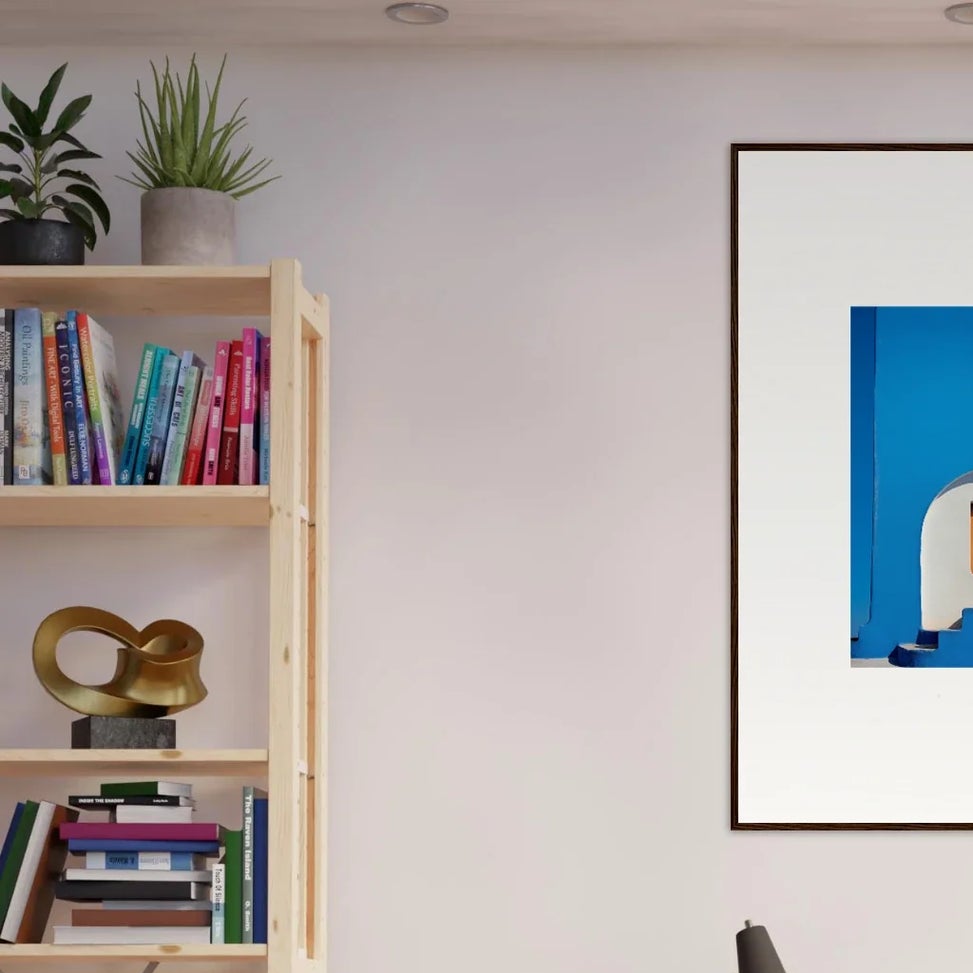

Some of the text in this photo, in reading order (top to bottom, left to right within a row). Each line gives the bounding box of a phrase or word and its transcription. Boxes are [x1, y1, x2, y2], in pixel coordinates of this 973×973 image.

[19, 325, 32, 385] Oil Paintings
[47, 347, 55, 364] FINE
[48, 365, 56, 379] ART
[59, 344, 73, 408] ICONIC
[73, 359, 81, 384] Beauty
[80, 327, 97, 411] Watercolor Portraits
[50, 384, 59, 401] With
[229, 363, 240, 416] Parenting Skills
[48, 402, 60, 425] Digital
[52, 426, 62, 442] Tools
[80, 440, 88, 472] NORMAN
[215, 868, 223, 884] Touch
